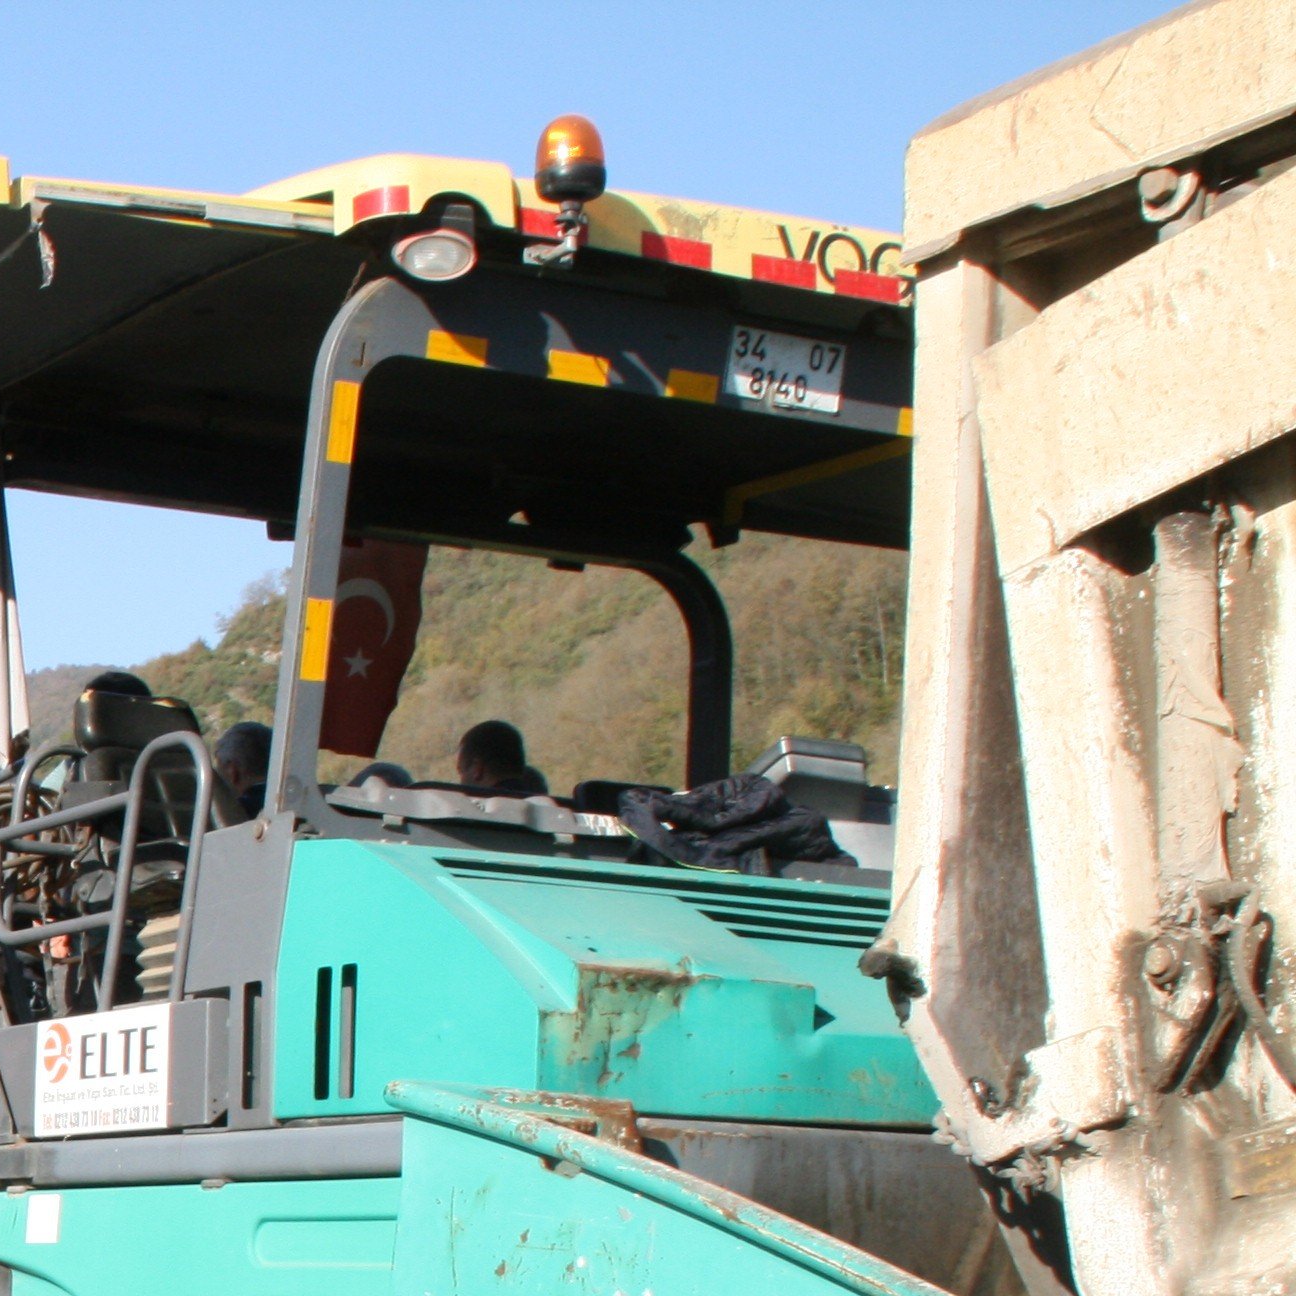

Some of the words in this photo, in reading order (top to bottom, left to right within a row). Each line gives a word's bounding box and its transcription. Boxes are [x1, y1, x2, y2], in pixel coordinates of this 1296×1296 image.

[735, 330, 766, 361] 34
[809, 344, 841, 375] 07
[749, 367, 807, 402] 8140
[79, 1025, 158, 1080] ELTE
